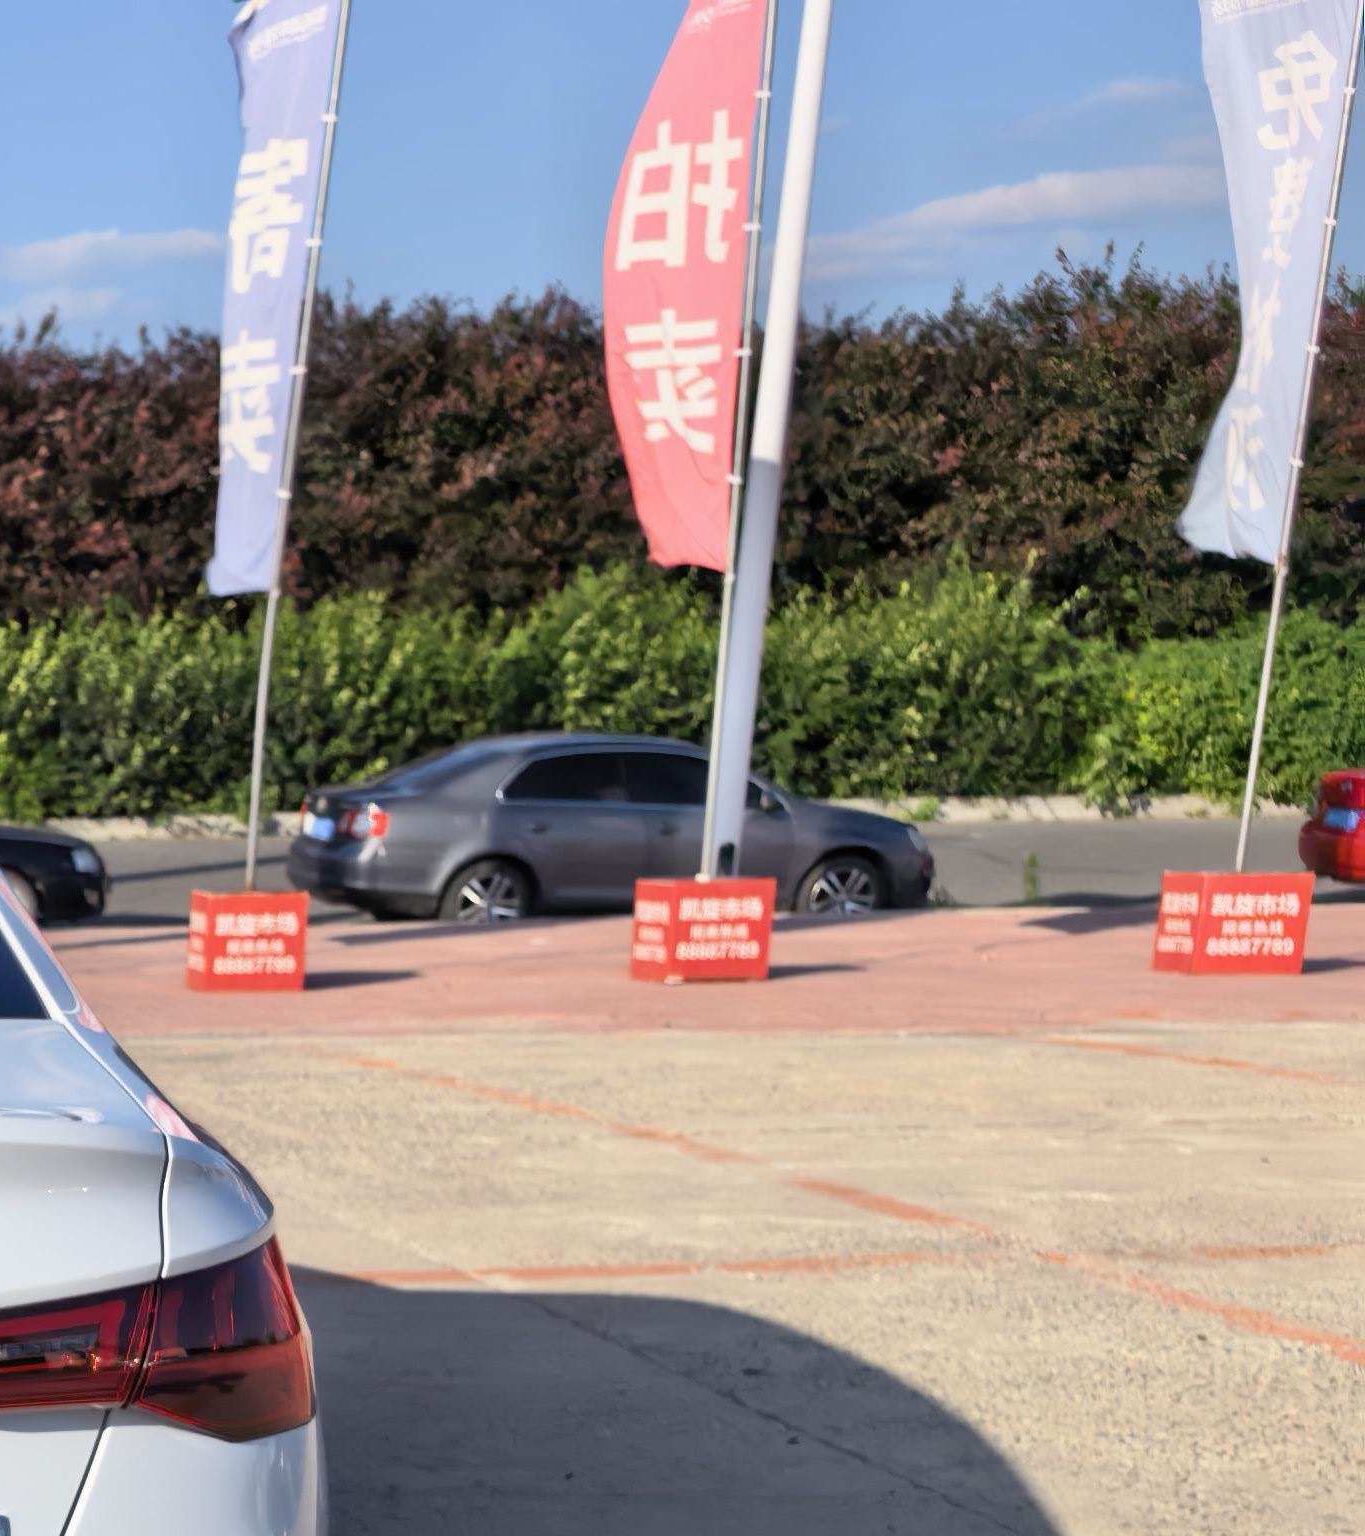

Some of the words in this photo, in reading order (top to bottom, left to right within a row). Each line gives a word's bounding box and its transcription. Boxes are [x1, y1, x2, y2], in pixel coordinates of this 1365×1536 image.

[678, 896, 763, 921] 凯旋市场
[1211, 892, 1300, 917] 凯旋市场
